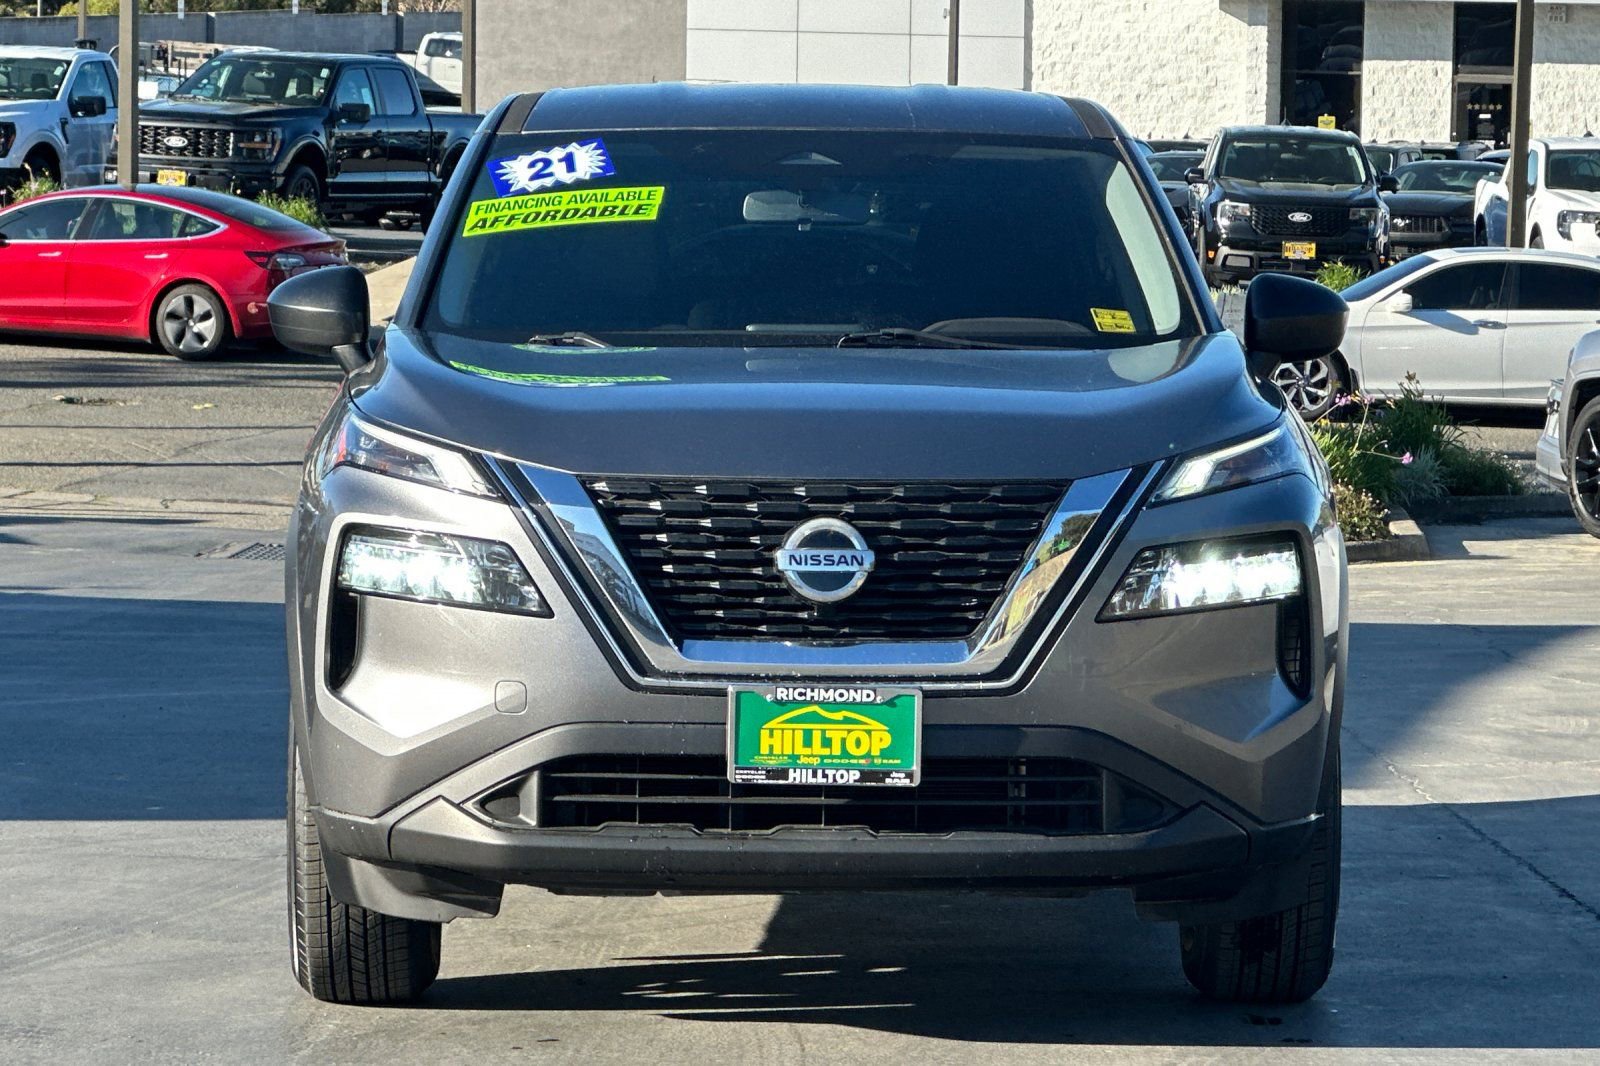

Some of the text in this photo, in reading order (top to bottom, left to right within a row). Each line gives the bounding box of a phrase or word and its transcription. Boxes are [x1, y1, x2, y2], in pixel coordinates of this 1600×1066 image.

[527, 151, 577, 181] 21
[475, 190, 657, 215] FINANCING AVAILABLE
[467, 203, 655, 232] AFFORDABLE
[789, 554, 864, 567] NISSAN
[776, 687, 875, 703] RICHMOND
[760, 729, 892, 756] HILLTOP
[796, 755, 820, 766] Jeep
[788, 768, 861, 784] HILLTOP
